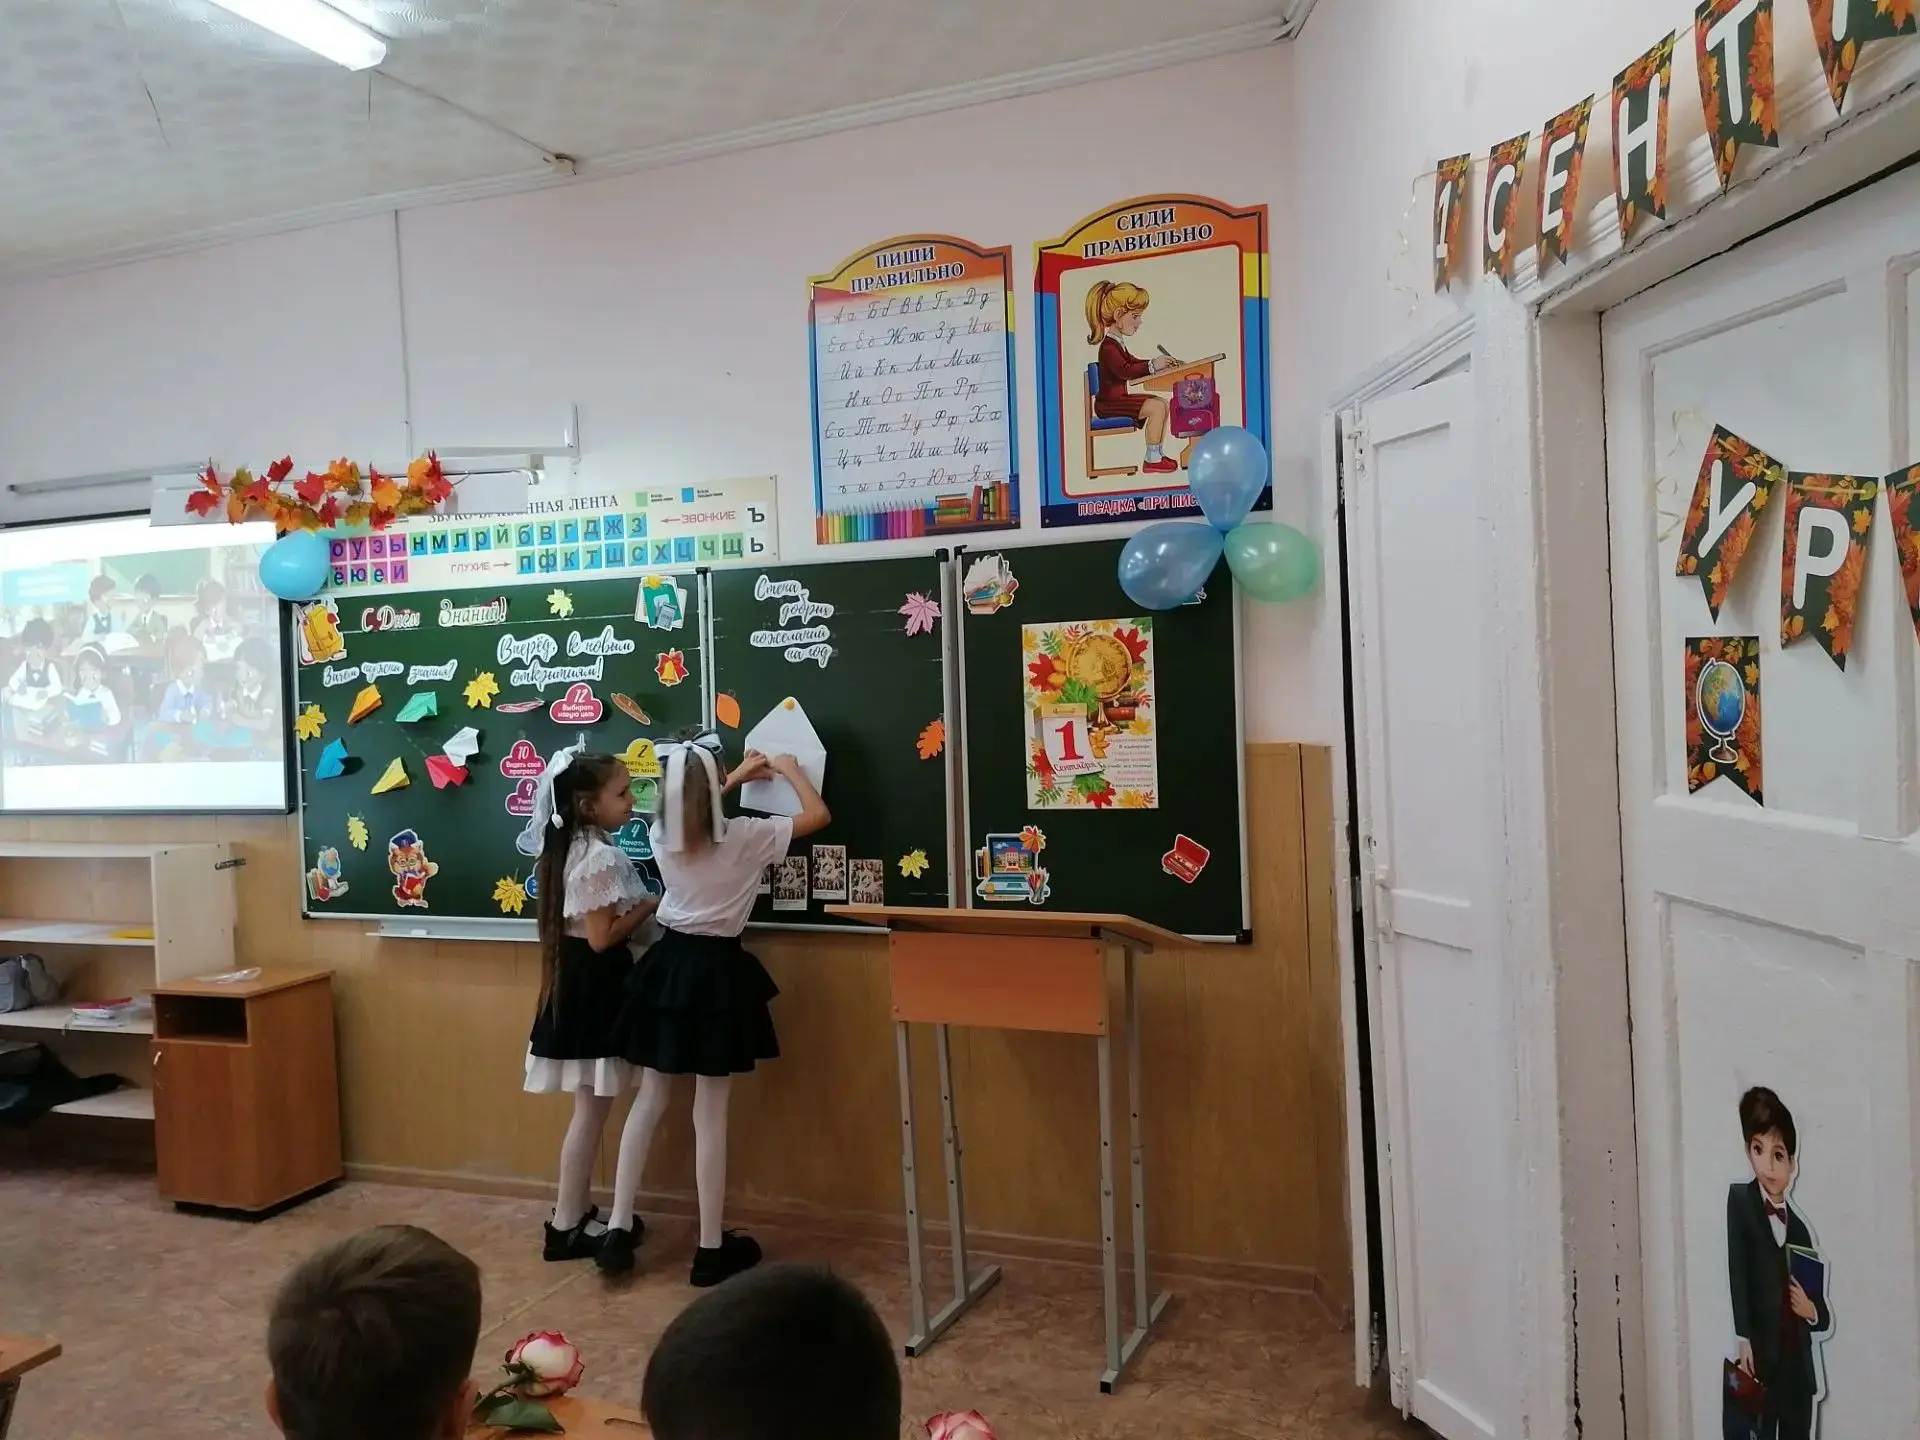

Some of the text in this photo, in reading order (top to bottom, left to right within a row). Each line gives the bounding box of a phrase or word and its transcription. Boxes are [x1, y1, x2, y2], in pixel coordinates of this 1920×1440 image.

[1116, 207, 1176, 230] СИДИ
[1435, 180, 1452, 259] 1
[1083, 224, 1213, 258] ПРАВИЛЬНО
[875, 246, 935, 268] ПИШИ
[851, 262, 964, 293] ПРАВИЛЬНО
[569, 495, 619, 510] ЛЕНТА
[1078, 498, 1136, 516] ПОСАДКА
[1171, 494, 1199, 509] ПИС
[681, 511, 736, 524] ЗВОНКИЕ
[451, 561, 490, 573] ГЛУХИЕ
[757, 577, 798, 598] Стена
[439, 596, 507, 627] Знаний!
[586, 627, 632, 653] новым
[512, 658, 601, 690] открытиям!
[573, 688, 589, 704] 12
[638, 744, 649, 758] 2
[1055, 720, 1084, 760] 1
[518, 745, 530, 760] 10
[525, 782, 533, 797] 9
[630, 824, 640, 839] 4
